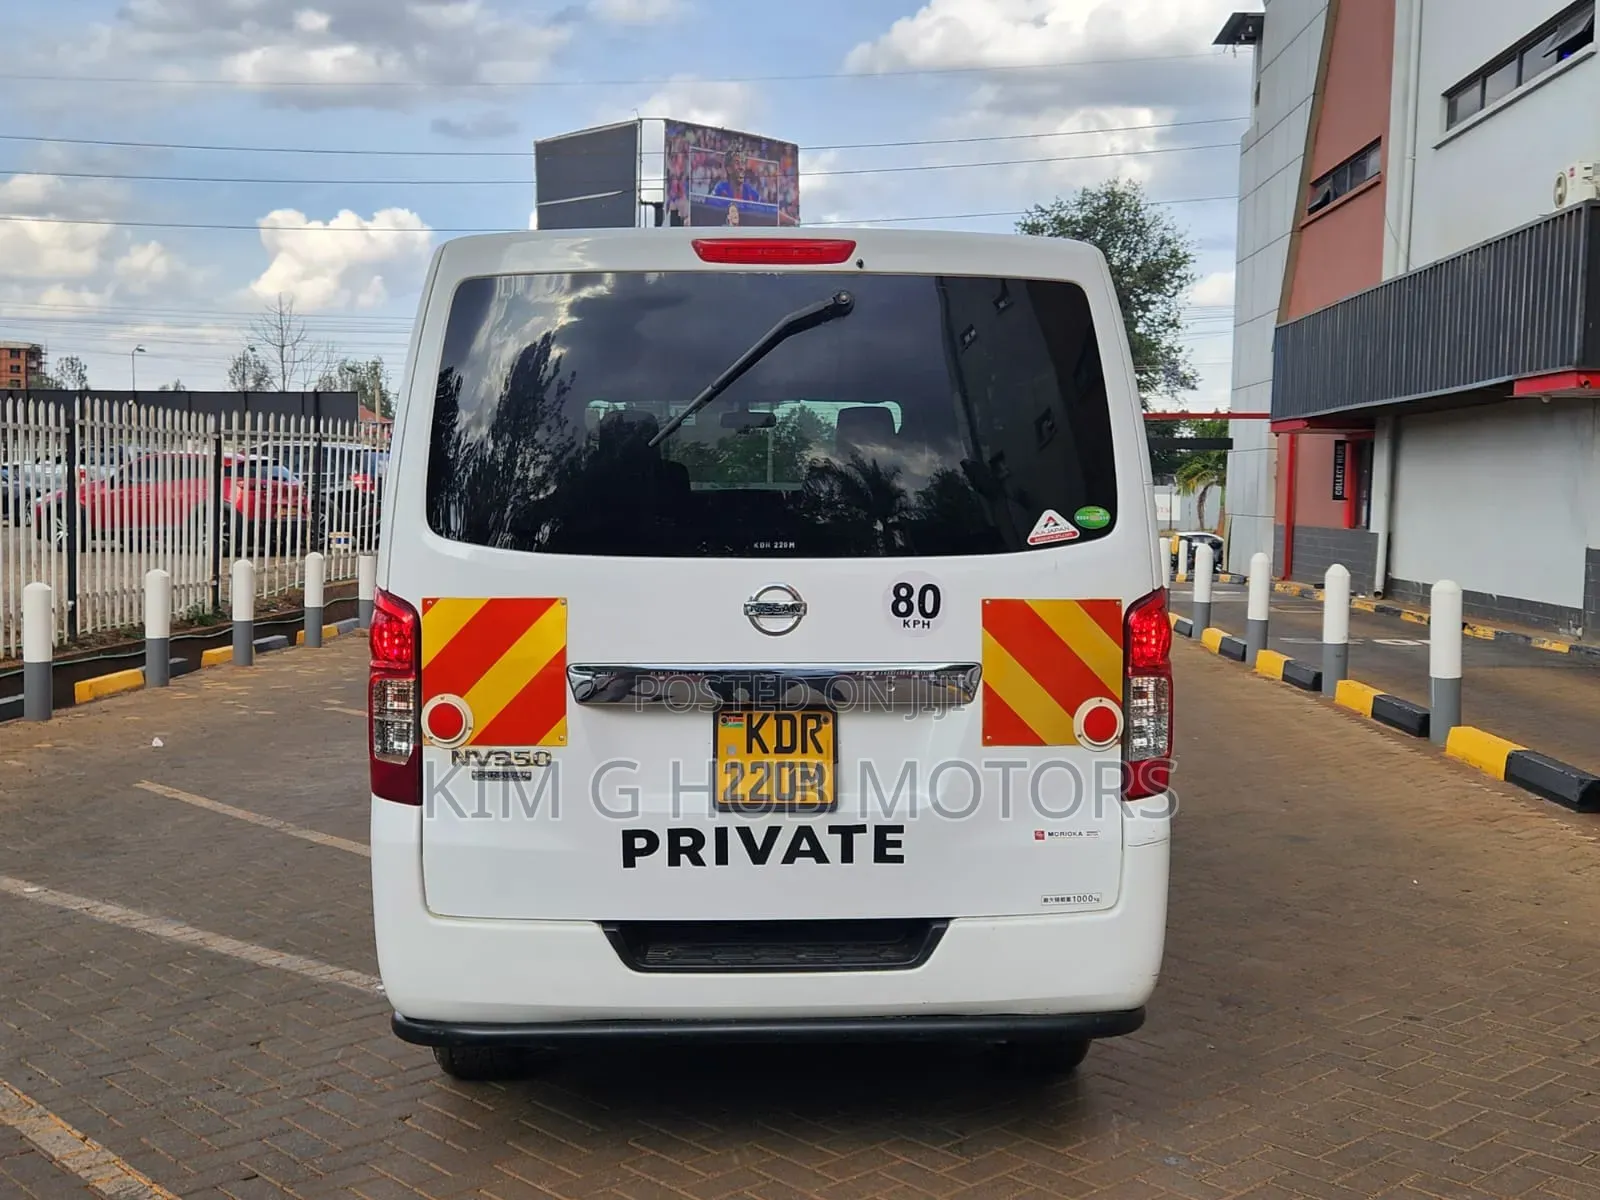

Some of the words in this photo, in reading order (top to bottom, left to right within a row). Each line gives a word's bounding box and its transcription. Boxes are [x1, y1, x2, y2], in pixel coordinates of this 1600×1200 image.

[1335, 465, 1344, 496] COLLECT
[891, 582, 941, 619] 80
[902, 619, 931, 629] KPH
[746, 713, 824, 754] KDR
[451, 750, 552, 767] NV350
[723, 761, 825, 801] 220M
[621, 824, 905, 868] PRIVATE
